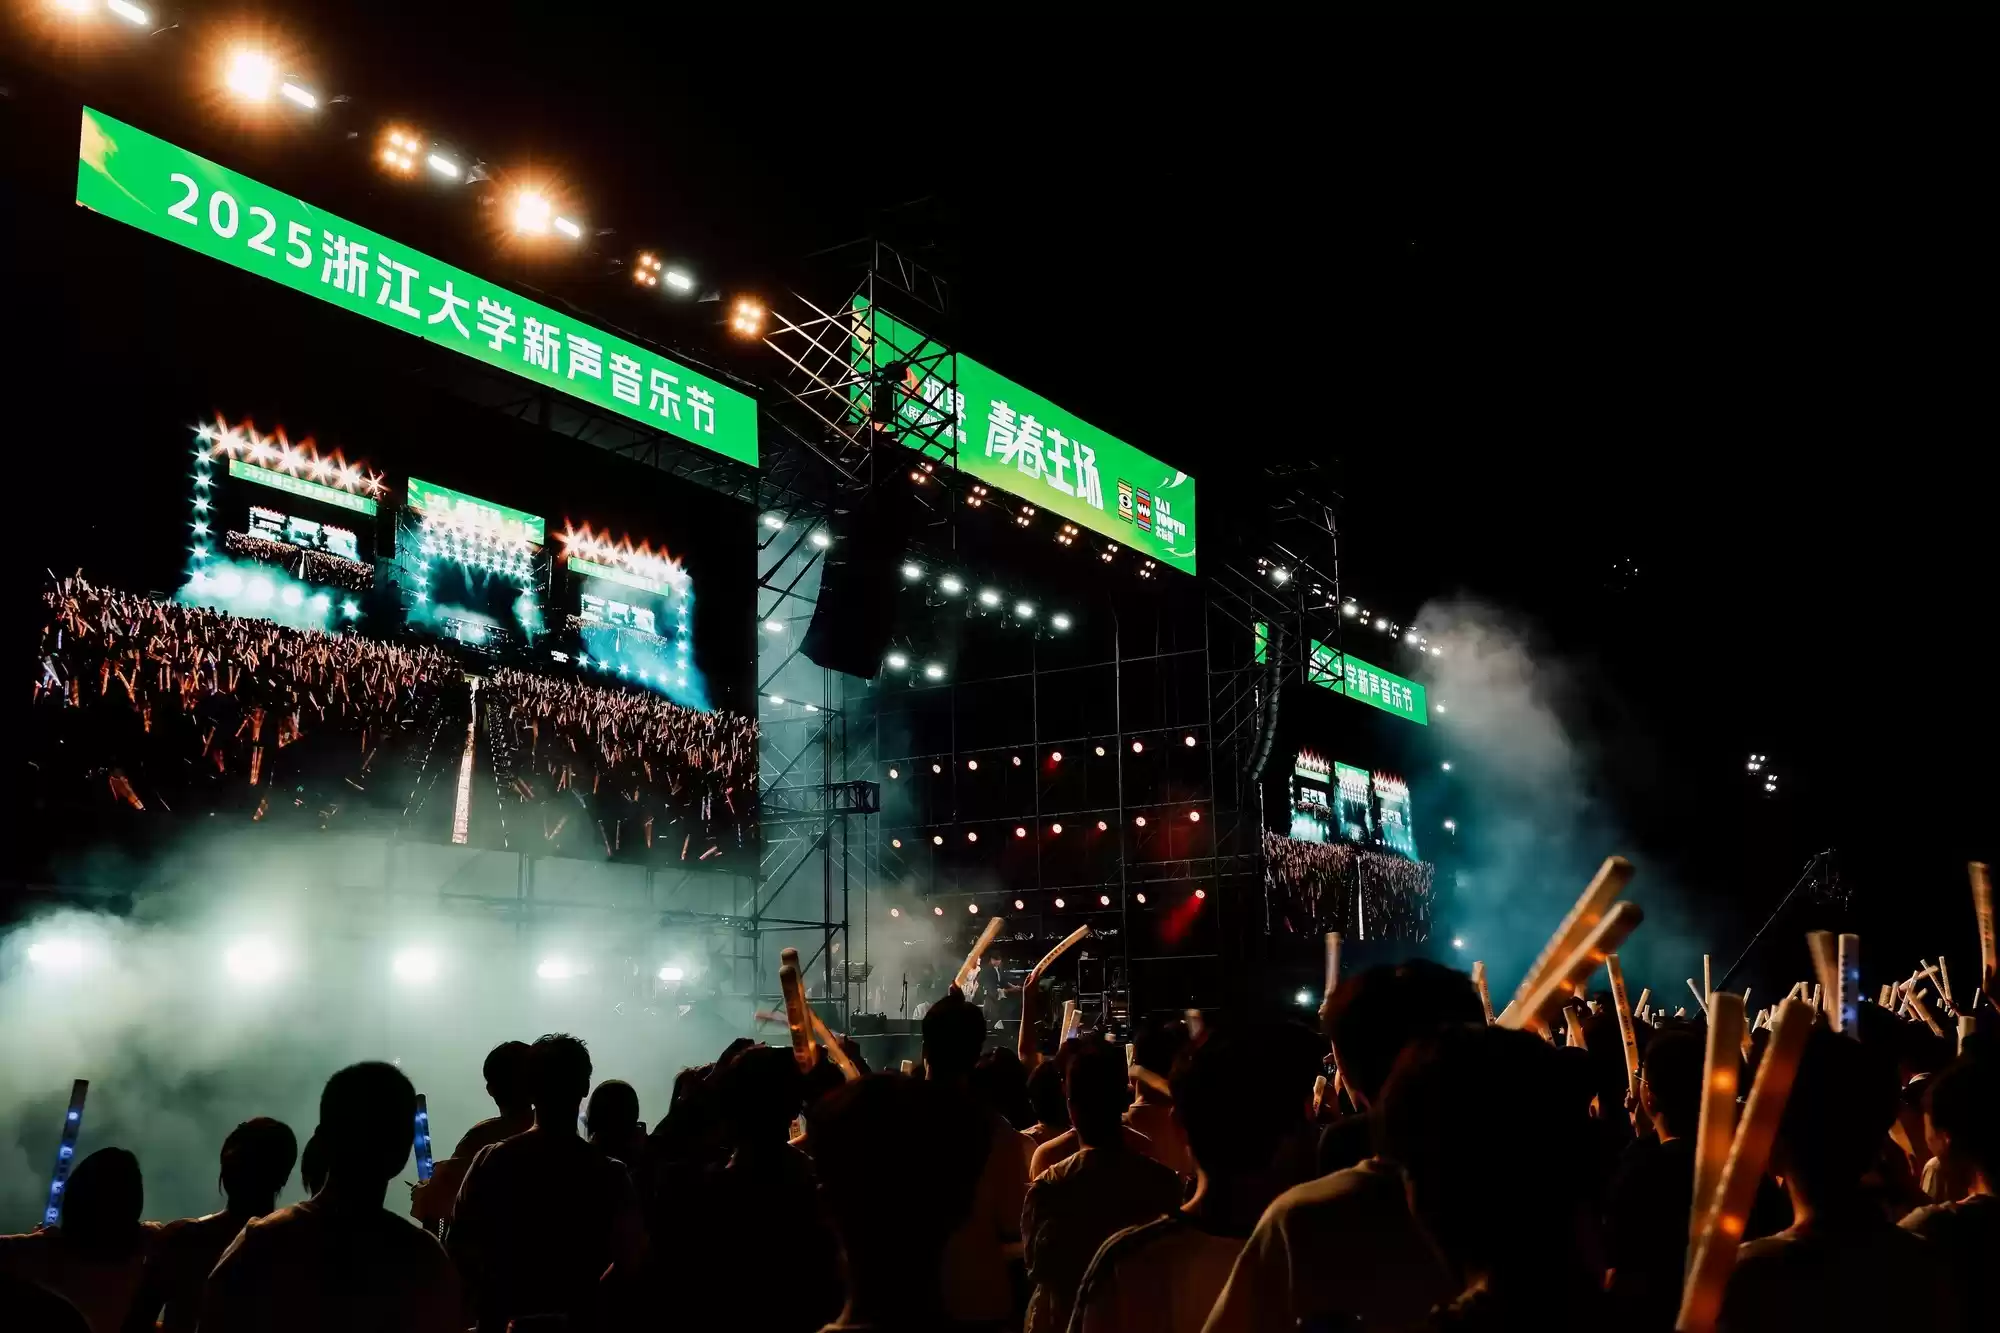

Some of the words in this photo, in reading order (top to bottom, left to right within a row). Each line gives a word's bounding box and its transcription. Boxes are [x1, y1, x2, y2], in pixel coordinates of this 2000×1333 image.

[167, 173, 715, 434] 2025浙江大学新声音乐节
[985, 399, 1104, 510] 青春主场
